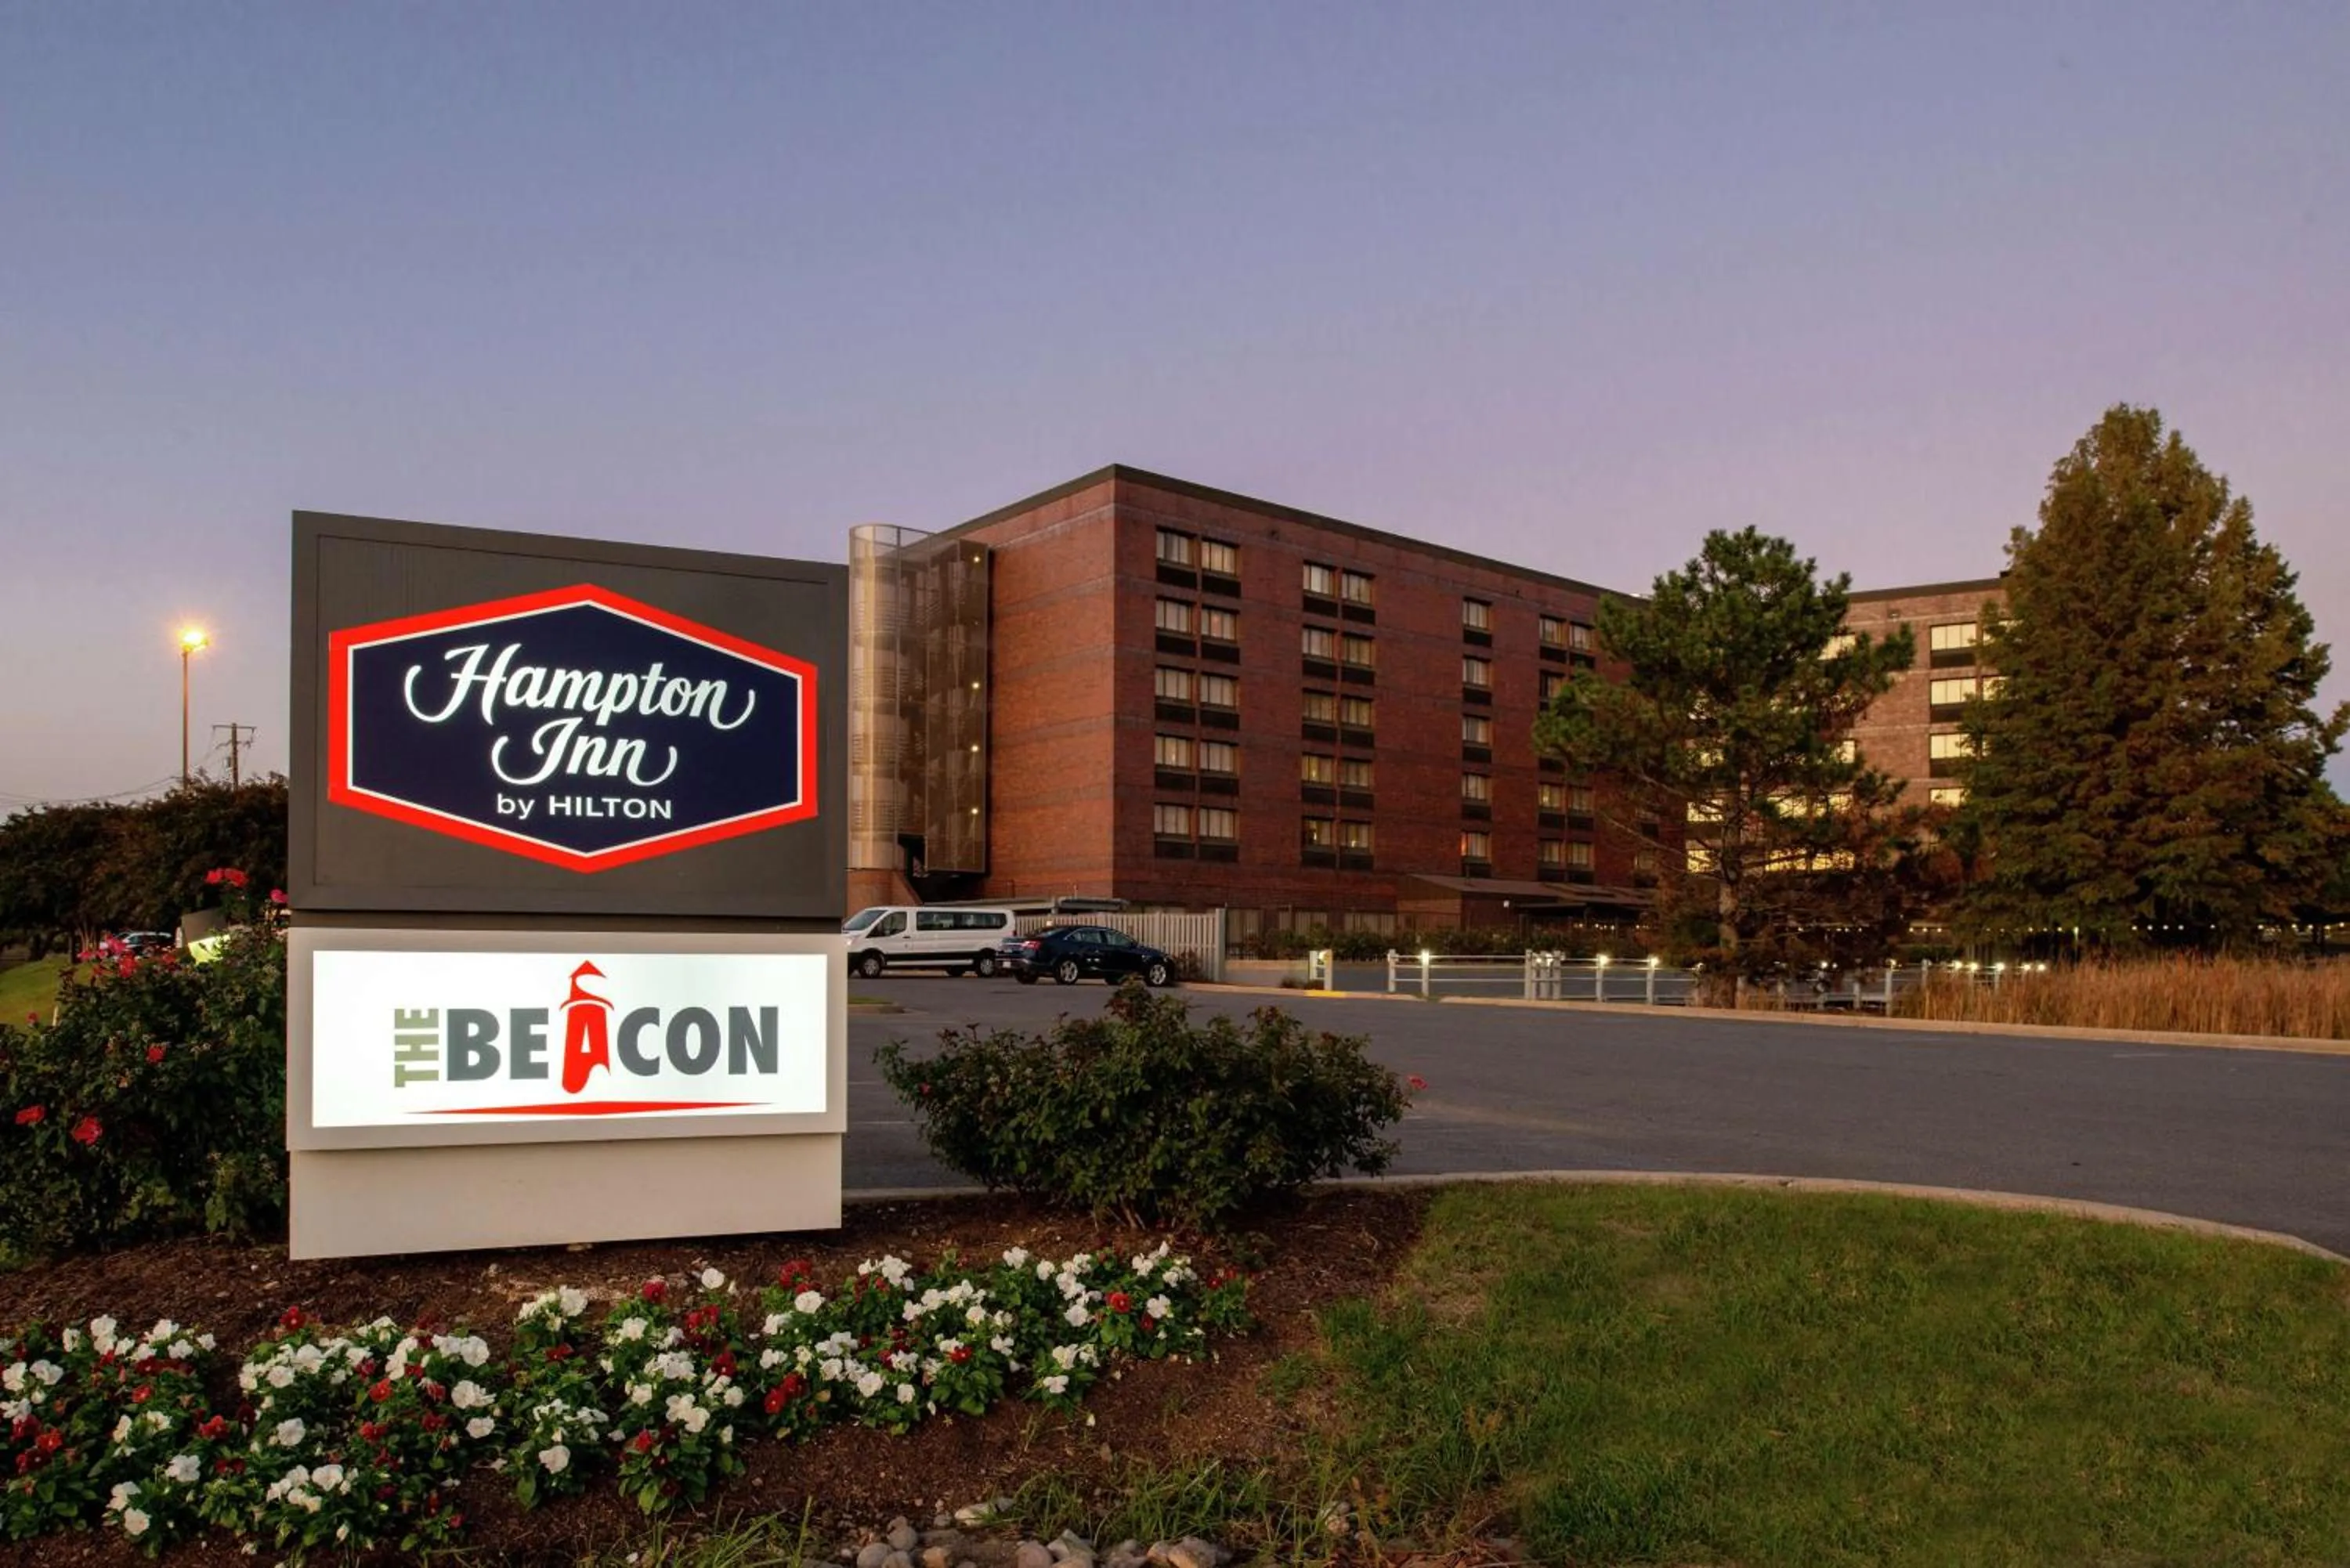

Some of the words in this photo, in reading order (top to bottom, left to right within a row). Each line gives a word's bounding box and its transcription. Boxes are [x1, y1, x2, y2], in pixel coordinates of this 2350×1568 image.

[403, 642, 756, 729] Hampton
[490, 717, 678, 786] Inn
[497, 793, 534, 819] by
[548, 795, 672, 818] HILTON
[394, 1008, 439, 1088] THE
[446, 999, 779, 1094] BEACON
